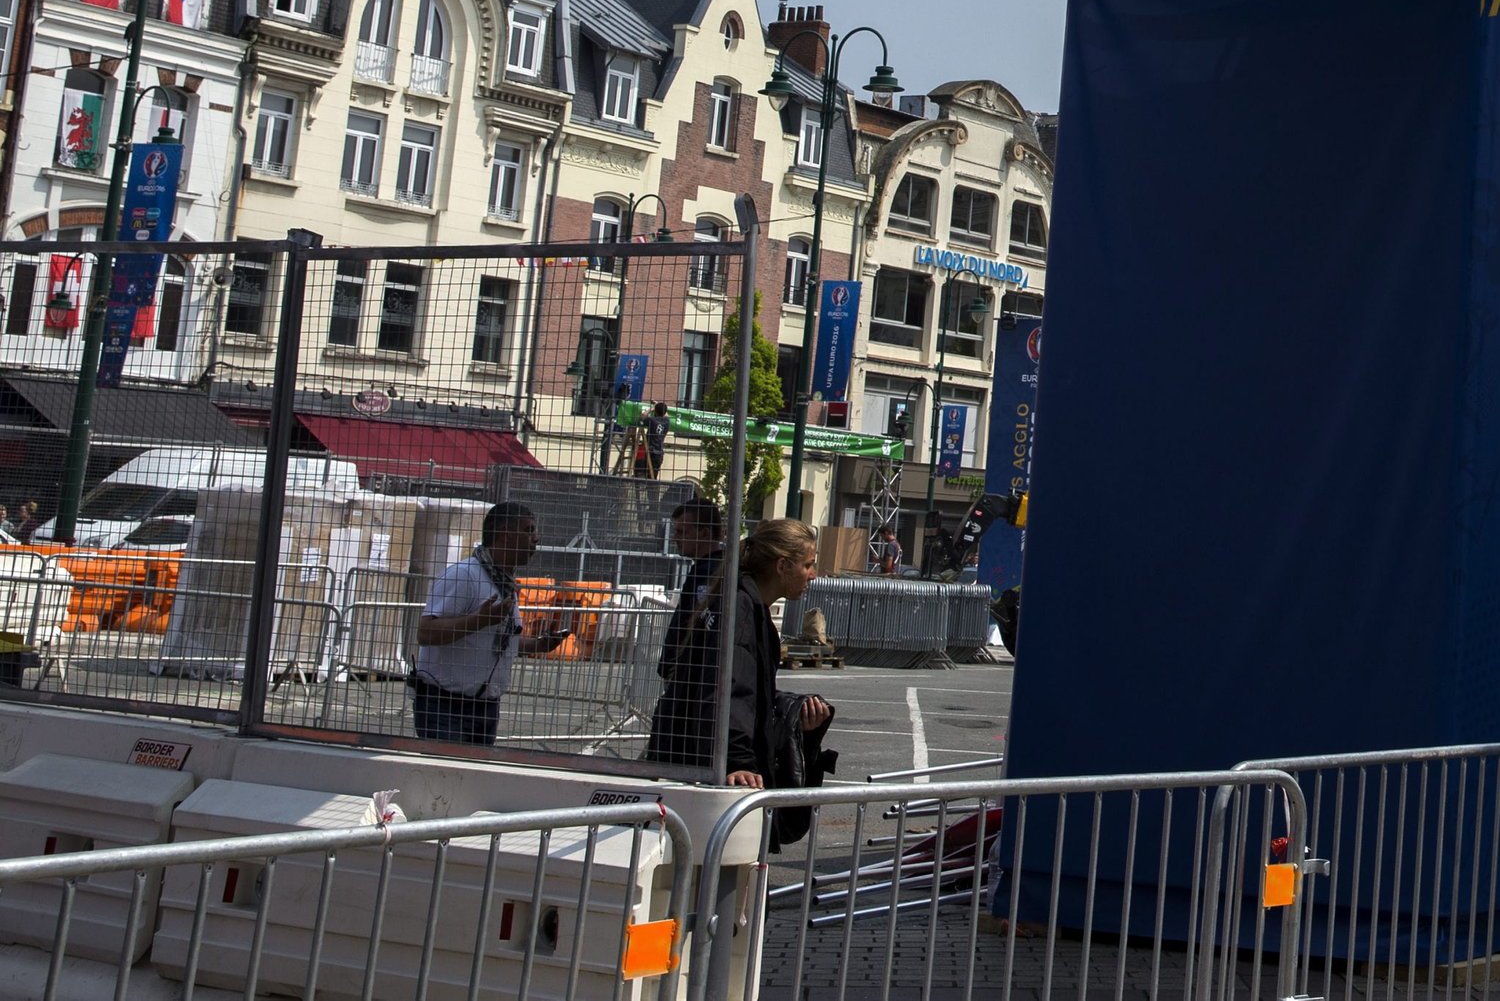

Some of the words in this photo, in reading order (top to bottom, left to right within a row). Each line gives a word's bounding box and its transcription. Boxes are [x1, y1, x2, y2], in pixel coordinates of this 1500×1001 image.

[917, 245, 933, 265] LA
[967, 256, 987, 277] DU
[988, 261, 1024, 283] NORD
[831, 325, 840, 346] 2016
[828, 346, 837, 367] EURO
[826, 367, 835, 388] UEFA
[1015, 403, 1029, 469] AGGLO
[135, 741, 174, 756] BORDER
[135, 754, 180, 769] BARRIERS
